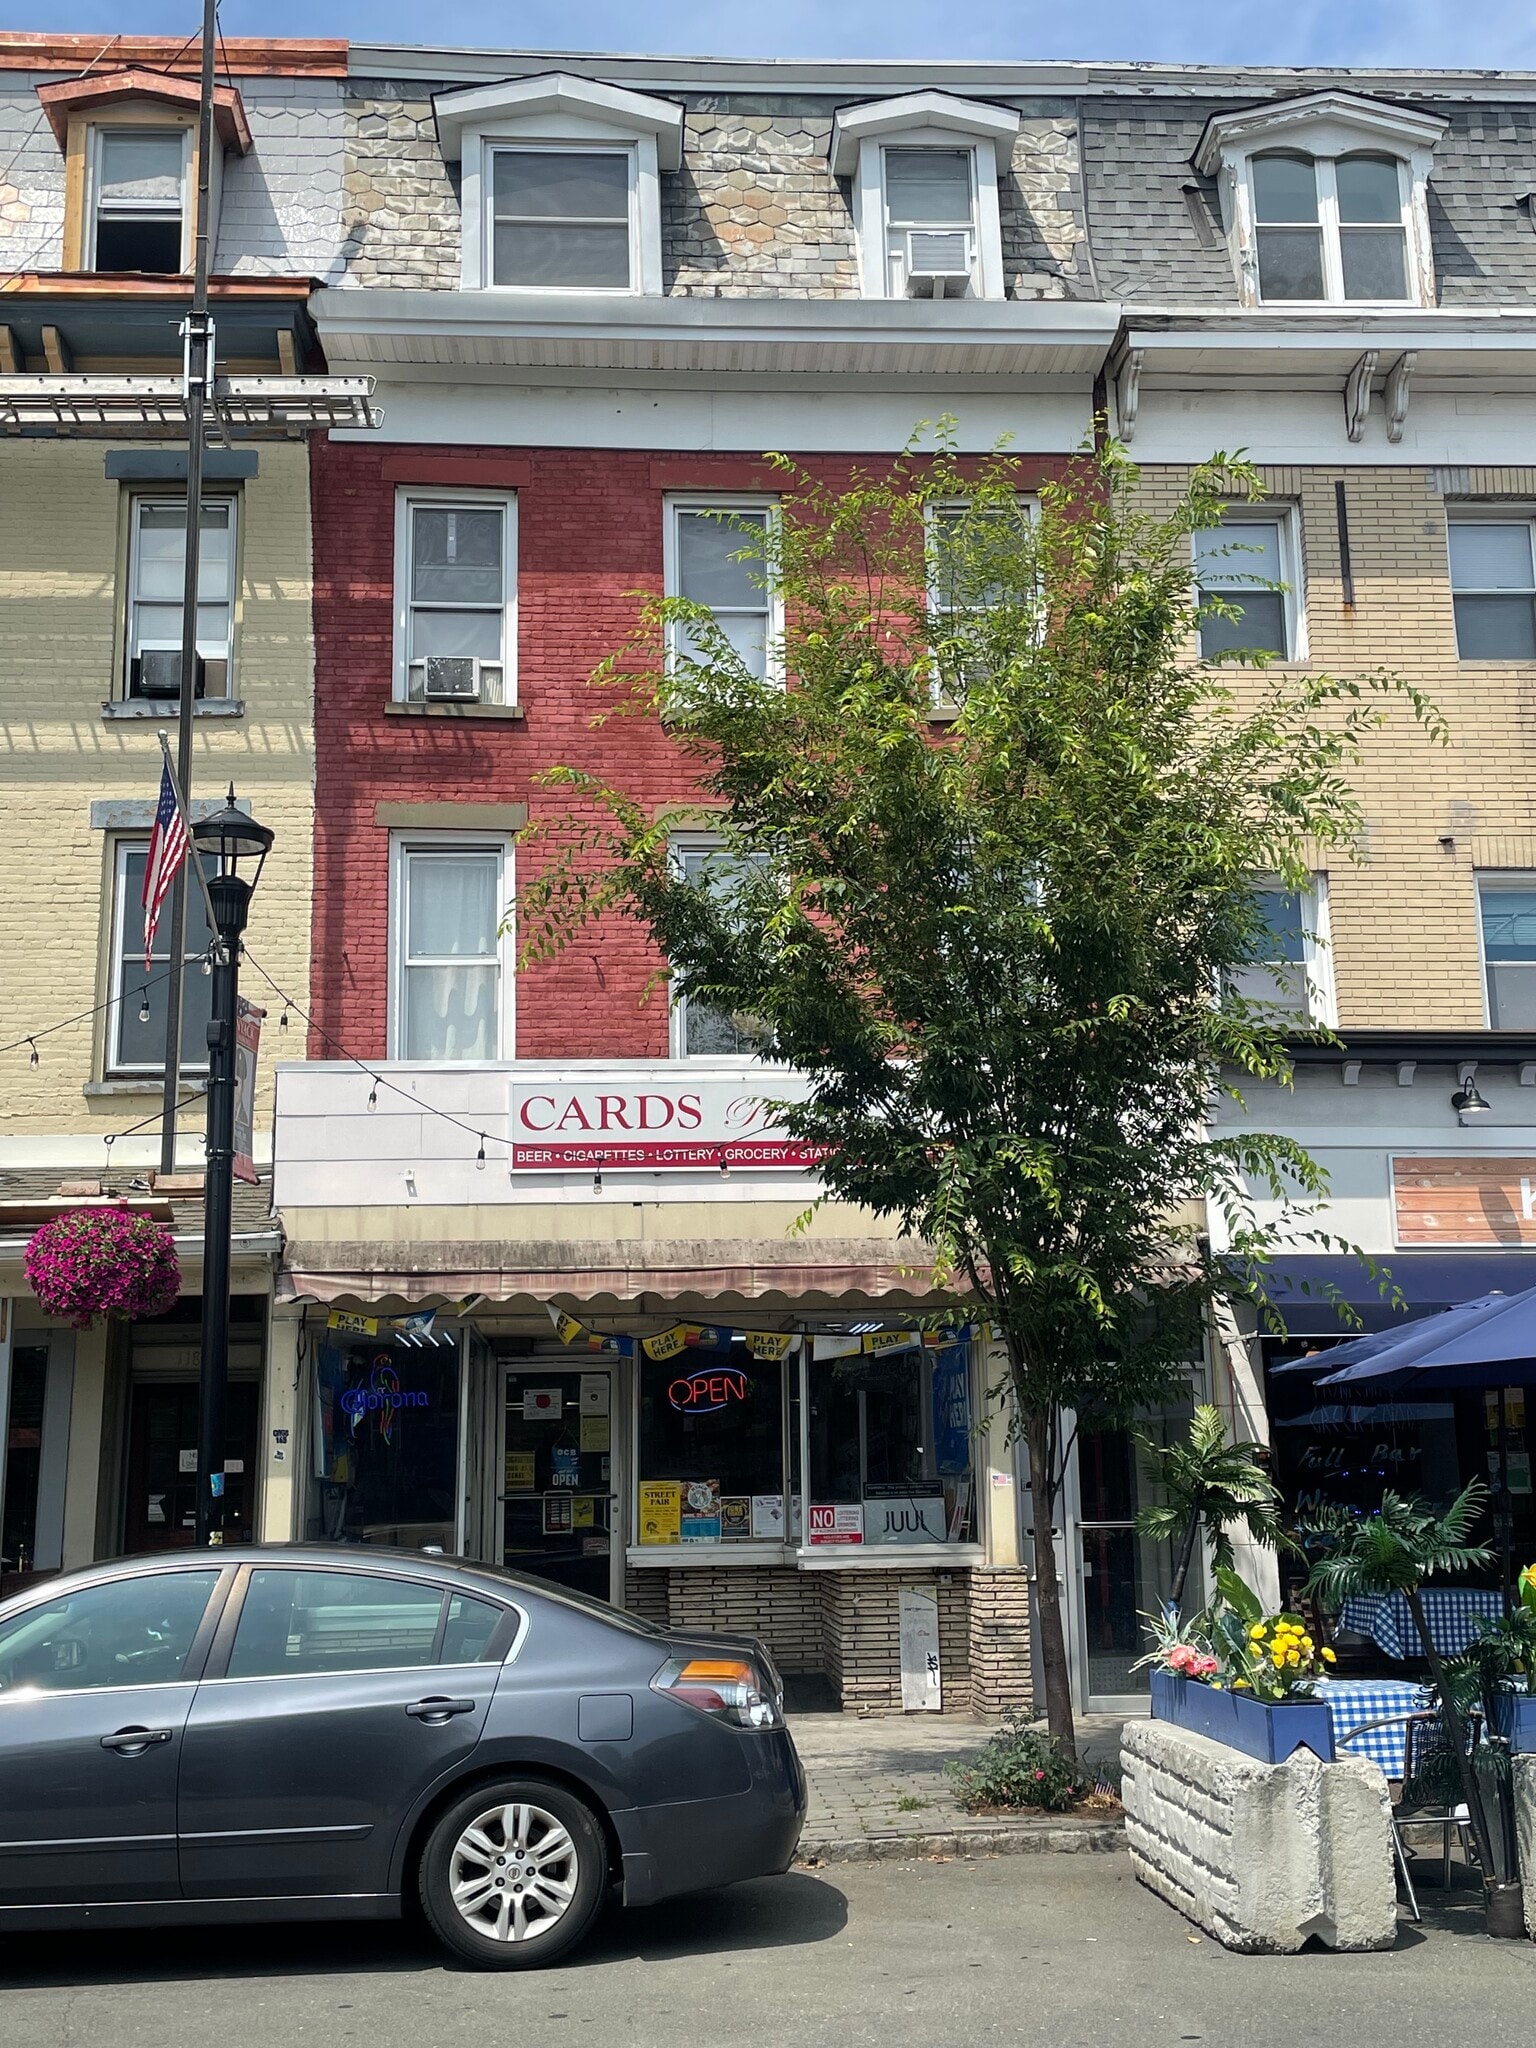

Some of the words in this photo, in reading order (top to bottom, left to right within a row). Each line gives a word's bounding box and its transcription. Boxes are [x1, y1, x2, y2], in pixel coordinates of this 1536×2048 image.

[520, 1094, 701, 1131] CARDS
[517, 1150, 552, 1162] BEER
[563, 1149, 645, 1162] CIGARETTES
[656, 1148, 714, 1161] LOTTERY
[724, 1147, 789, 1160] GROCERY
[337, 1314, 368, 1327] PLAY
[651, 1331, 677, 1349] PLAY
[753, 1335, 782, 1346] PLAY
[871, 1333, 900, 1346] PLAY
[652, 1339, 682, 1358] HERE
[753, 1345, 782, 1356] HERE
[668, 1375, 746, 1405] OPEN
[340, 1388, 429, 1416] Corona
[557, 1448, 577, 1456] OCB
[1297, 1446, 1345, 1469] Full
[1370, 1443, 1422, 1464] Bar
[552, 1473, 579, 1486] OPEN
[644, 1491, 676, 1499] STREET
[650, 1498, 670, 1506] FAIR
[812, 1509, 834, 1528] NO
[883, 1510, 928, 1533] JUUL
